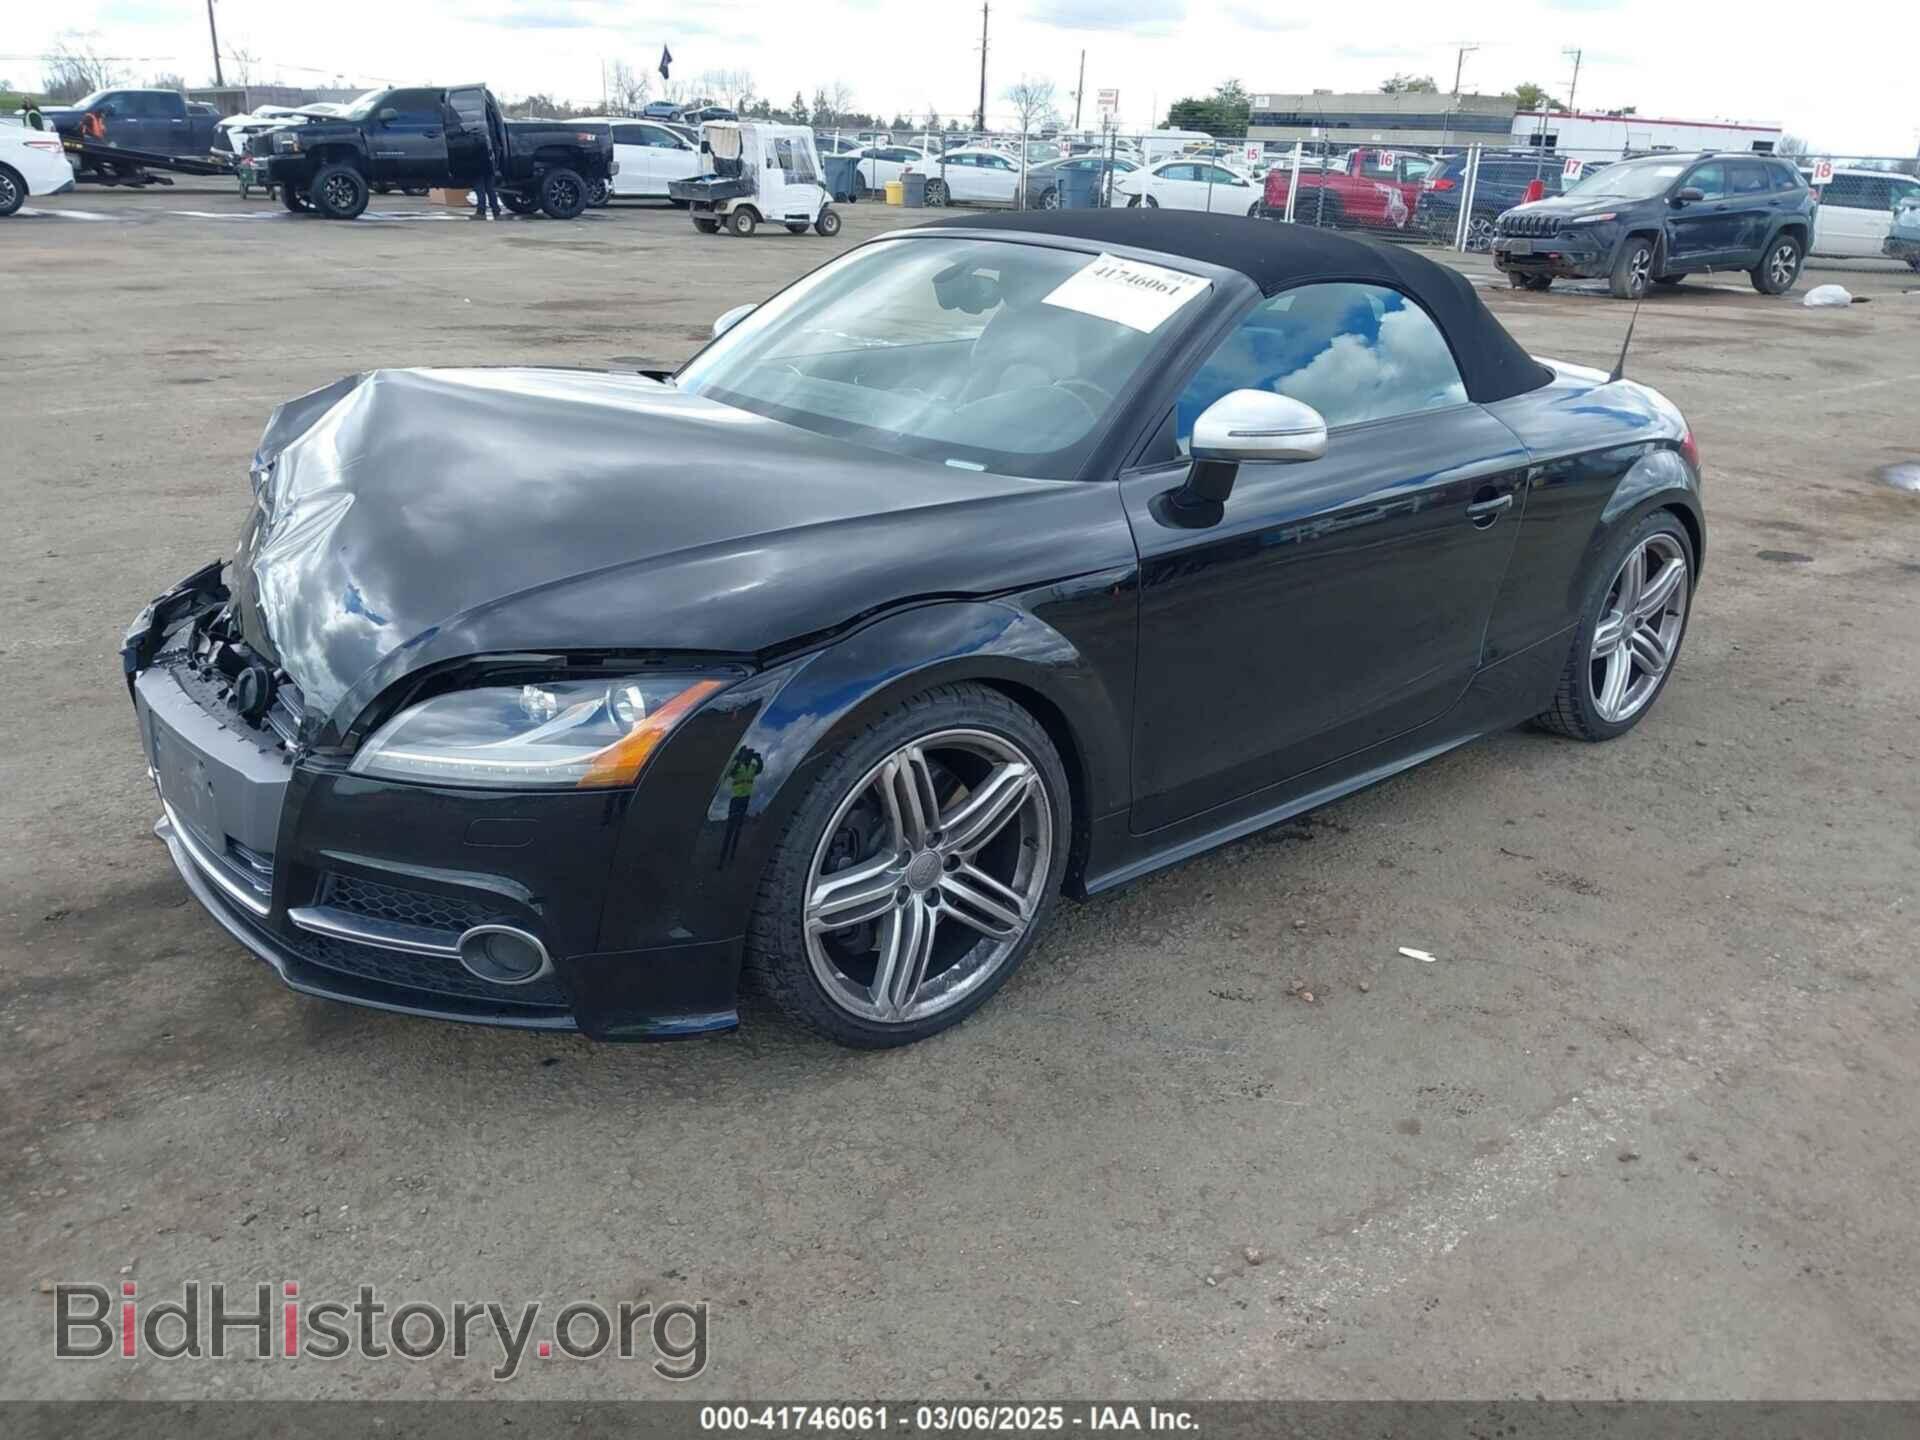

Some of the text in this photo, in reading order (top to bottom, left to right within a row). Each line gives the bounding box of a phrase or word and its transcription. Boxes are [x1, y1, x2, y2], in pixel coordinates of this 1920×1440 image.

[1247, 148, 1258, 160] 15
[1380, 152, 1393, 166] 16
[1565, 159, 1581, 174] 17
[1814, 162, 1832, 178] 18
[1094, 266, 1181, 296] 41746061
